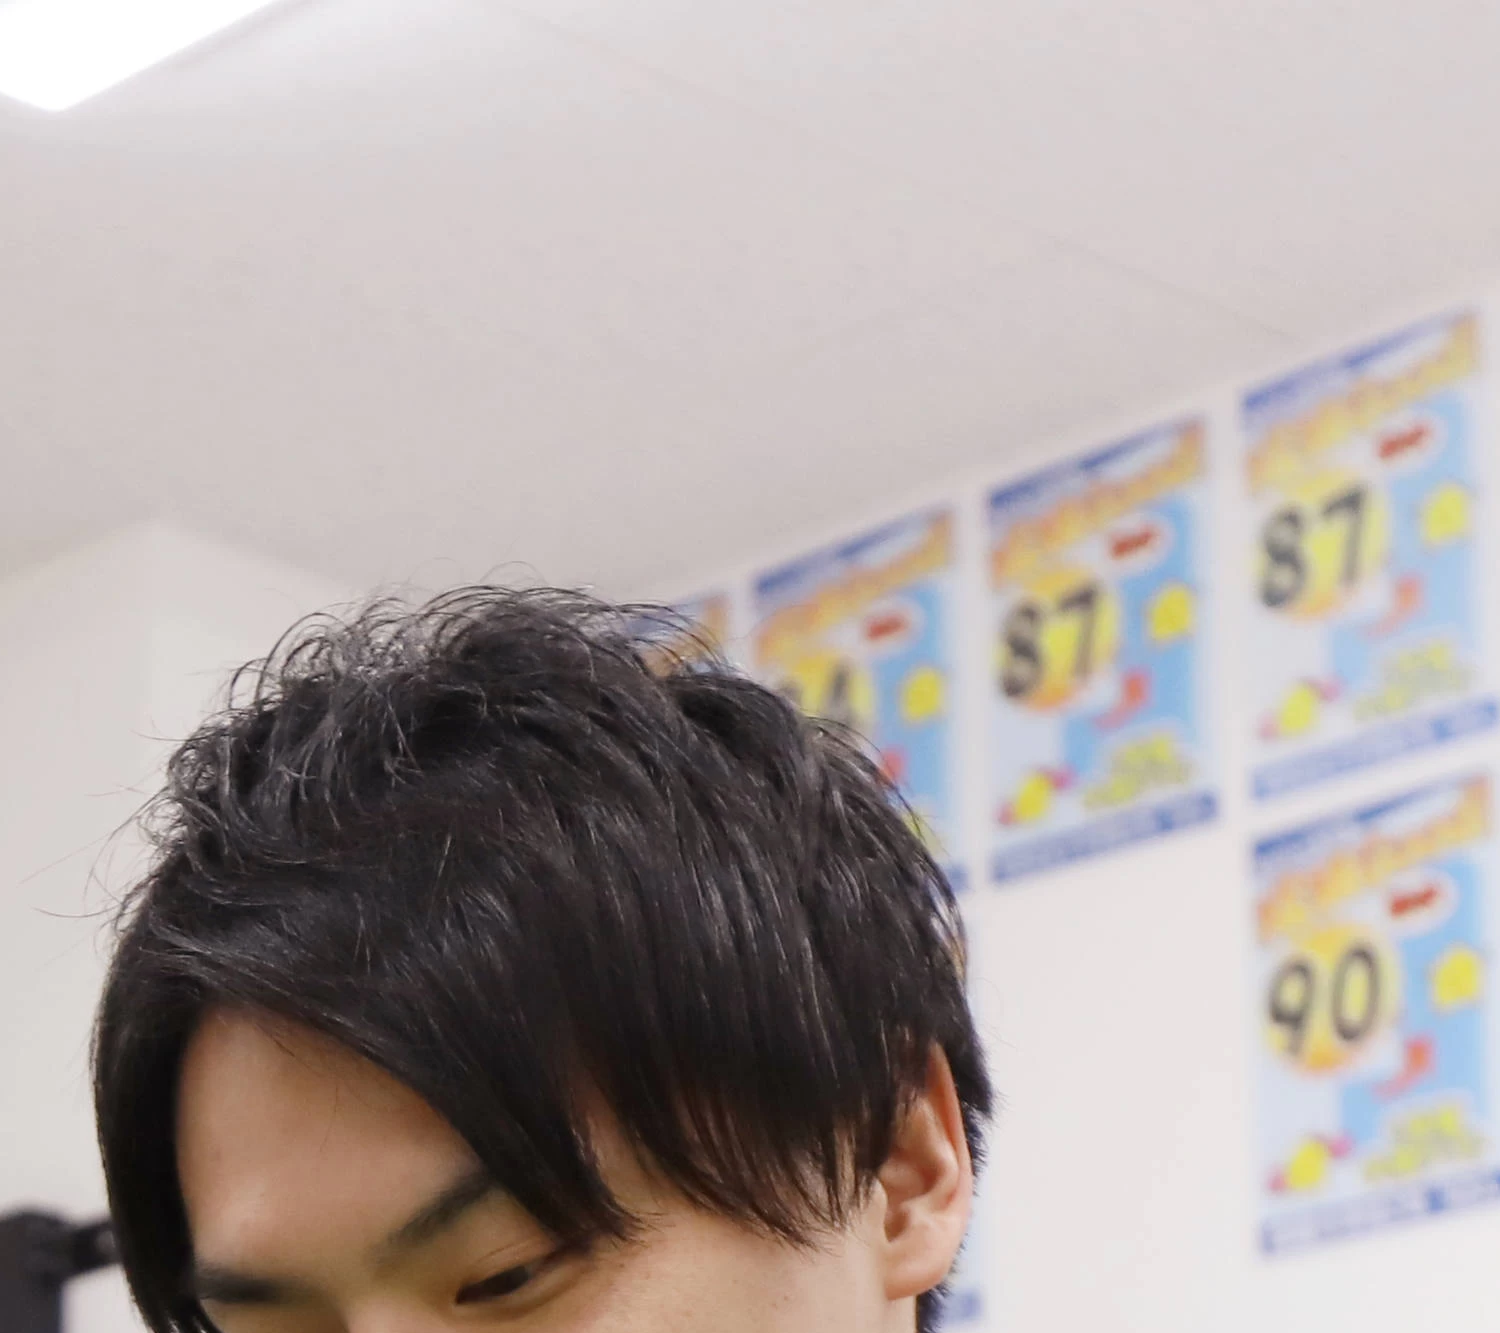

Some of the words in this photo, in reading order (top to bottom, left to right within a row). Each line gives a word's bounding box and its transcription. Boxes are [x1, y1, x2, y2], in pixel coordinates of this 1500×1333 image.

[1255, 485, 1367, 609] 87
[999, 583, 1105, 705] 87
[1266, 942, 1381, 1055] 90
